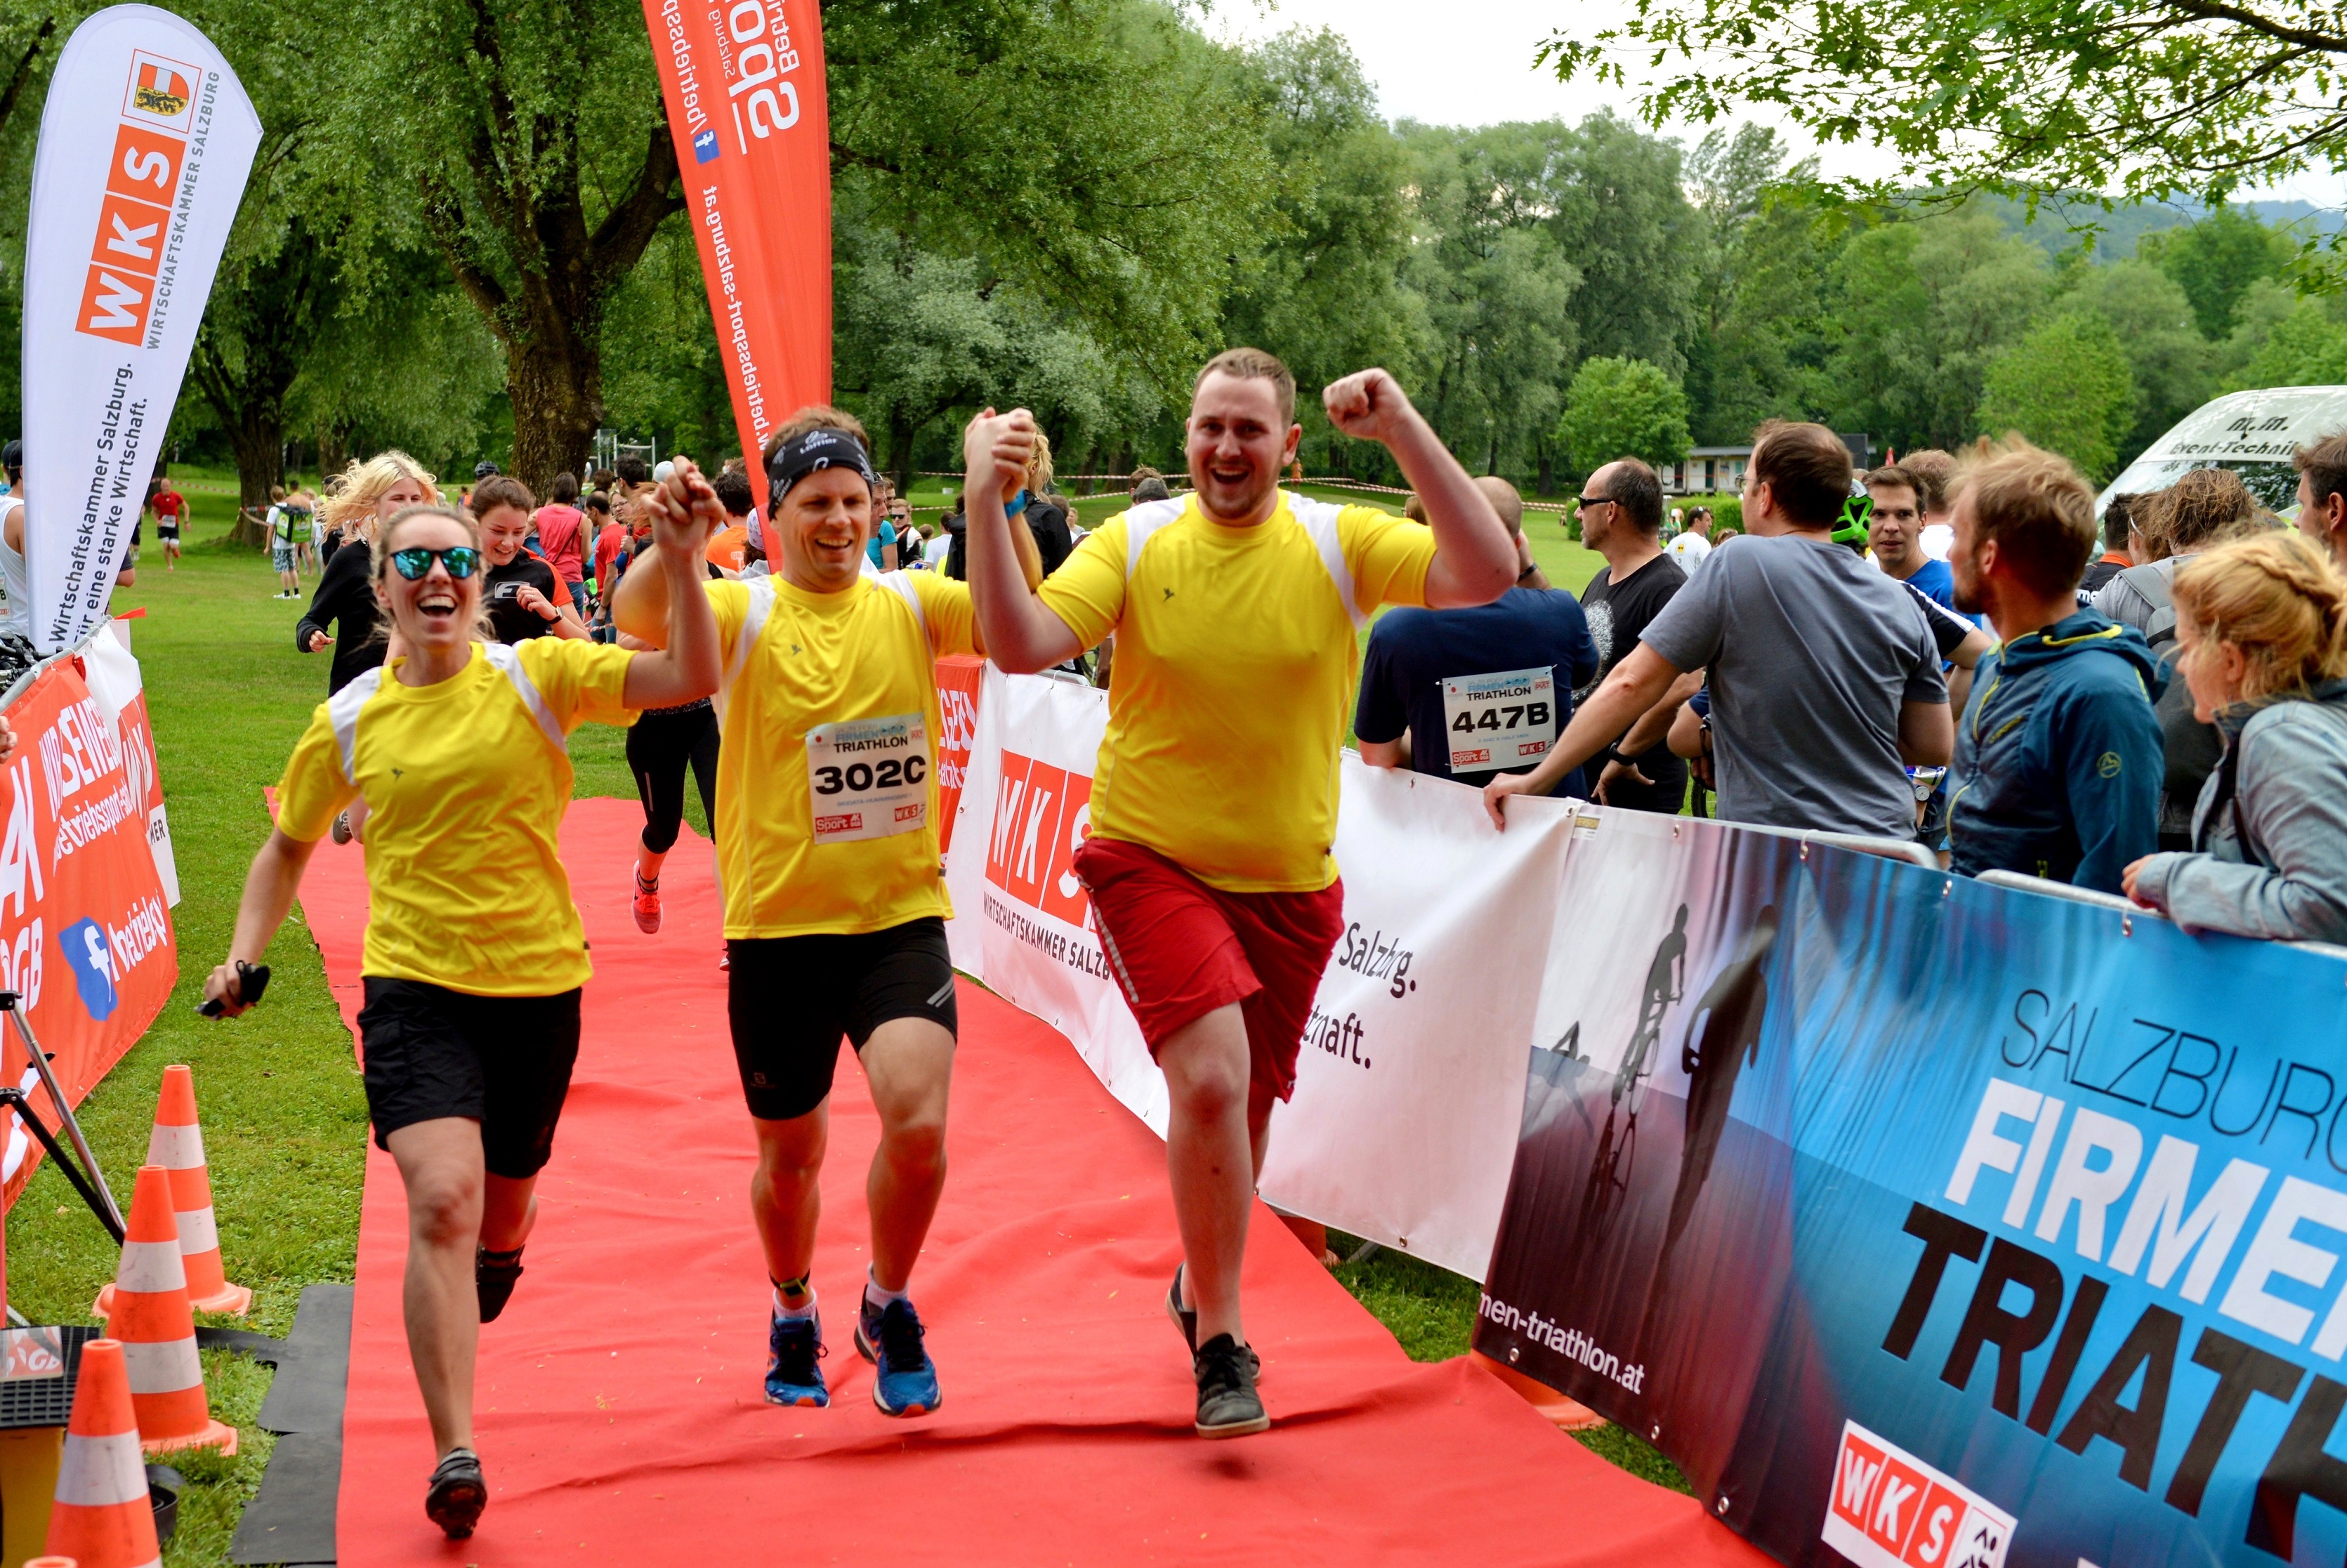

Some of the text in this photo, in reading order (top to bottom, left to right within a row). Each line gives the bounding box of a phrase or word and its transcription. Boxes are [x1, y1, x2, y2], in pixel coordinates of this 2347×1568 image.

[147, 71, 220, 350] WIRTSCHAFTSKAMMER SALZBURG
[89, 145, 171, 329] WKS
[110, 397, 148, 499] Wirtschaft.
[48, 362, 133, 642] Wirtschaftskammer Salzburg.
[98, 505, 123, 567] starke
[86, 569, 107, 610] eine
[1466, 686, 1531, 701] TRIATHLON
[1452, 701, 1550, 733] 447B
[834, 735, 909, 753] TRIATHLON
[1453, 753, 1478, 763] Sport
[1519, 743, 1544, 756] WKS
[815, 755, 926, 795] 302C
[817, 818, 848, 833] Sport
[895, 805, 918, 821] WKS
[983, 890, 1115, 982] WIRTSCHAFTSKAMMER SALZB
[1841, 1447, 1954, 1564] WKS
